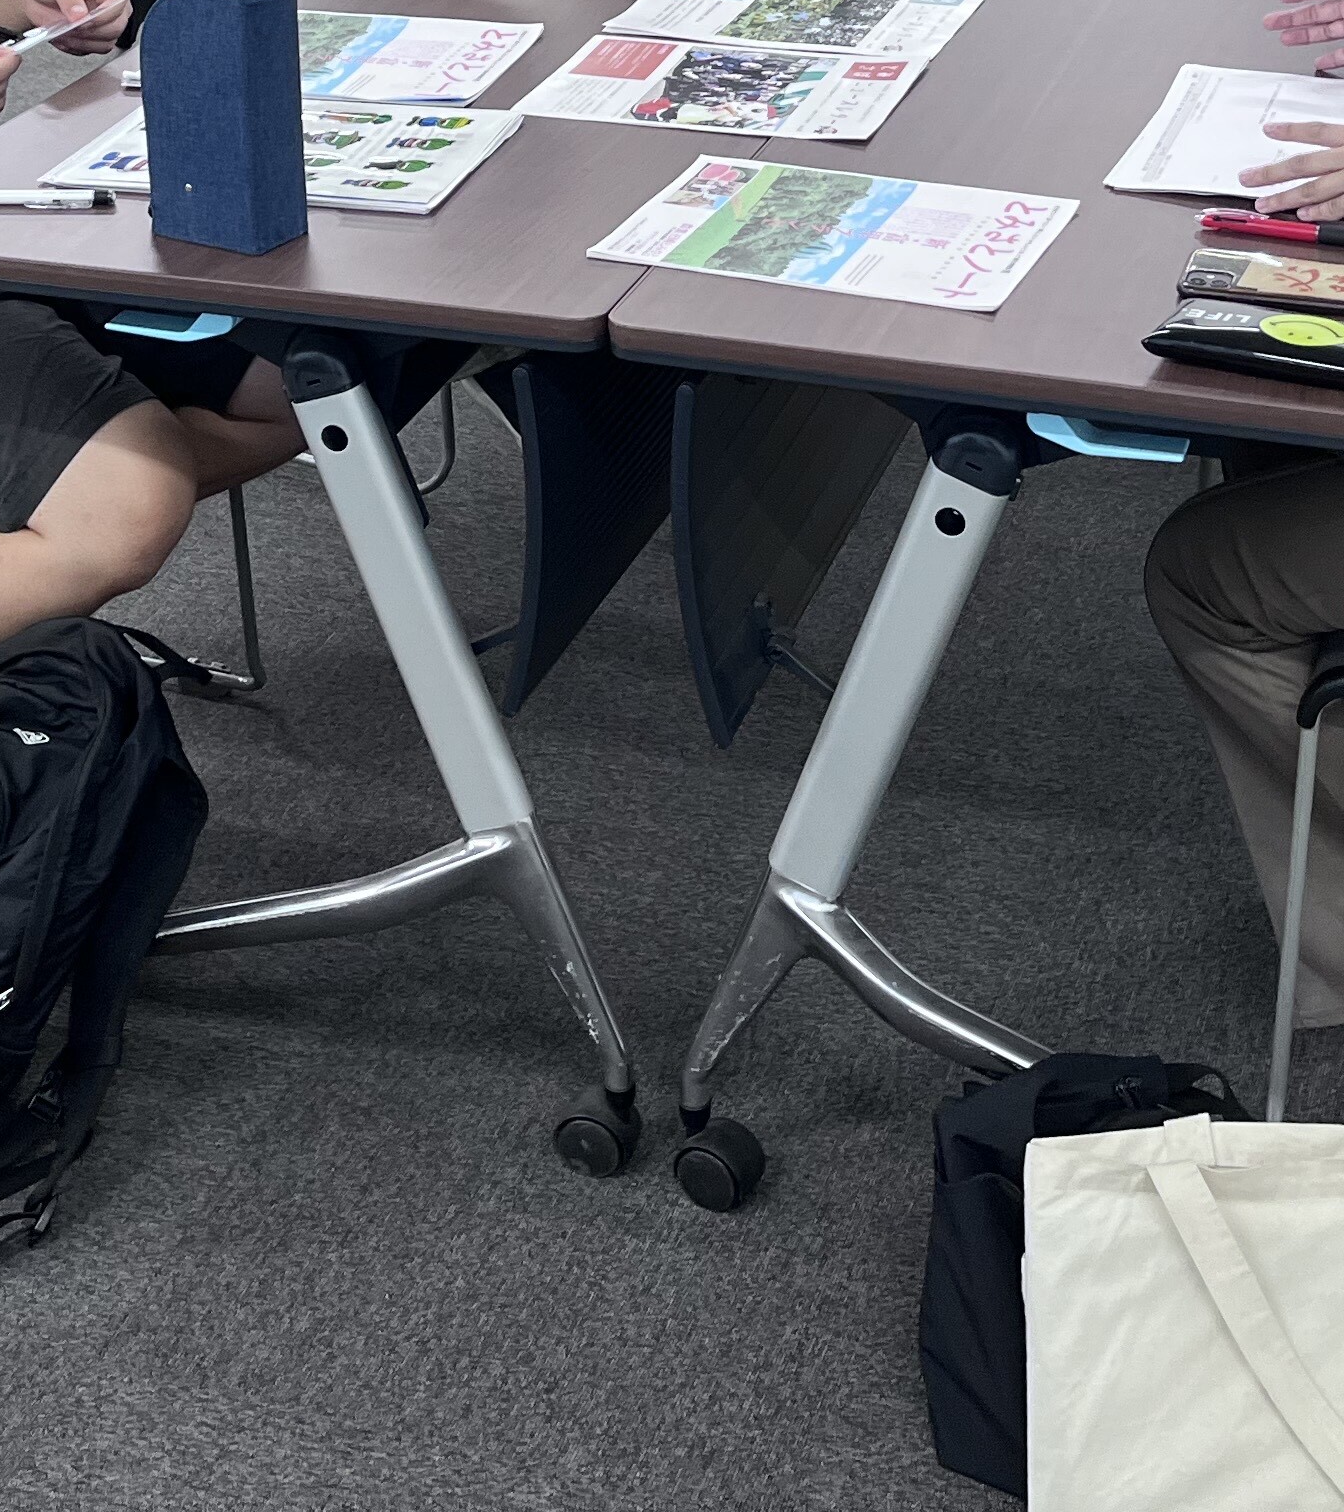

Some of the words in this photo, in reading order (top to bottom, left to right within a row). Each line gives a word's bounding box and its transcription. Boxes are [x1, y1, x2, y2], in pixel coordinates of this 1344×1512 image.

[933, 200, 1049, 299] とみさとノート
